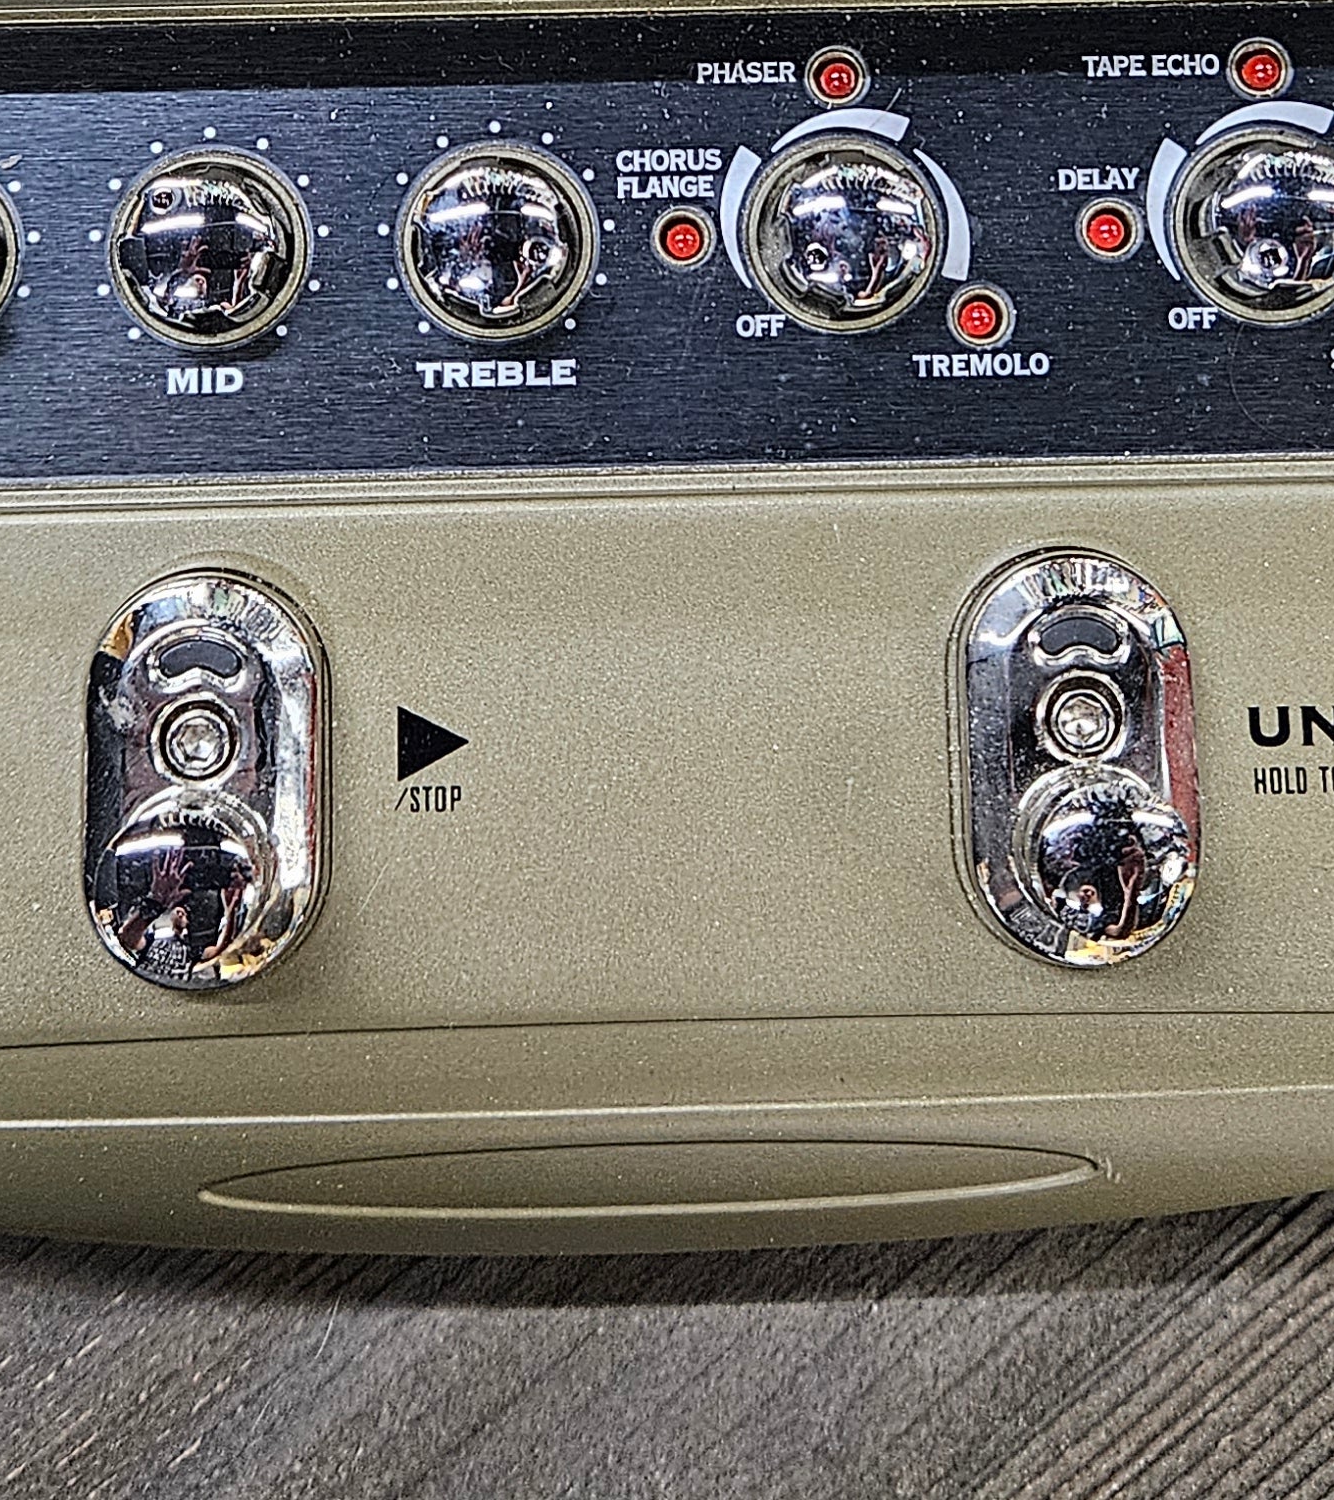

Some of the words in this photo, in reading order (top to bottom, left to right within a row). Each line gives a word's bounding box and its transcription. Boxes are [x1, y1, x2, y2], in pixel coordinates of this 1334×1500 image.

[696, 61, 797, 85] PHASER
[1081, 55, 1147, 78] TAPE
[1151, 53, 1220, 77] ECHO
[616, 148, 722, 173] CHORUS
[616, 174, 715, 199] FLANGE
[1057, 167, 1140, 192] DELAY
[735, 314, 786, 338] OFF
[1168, 306, 1217, 331] OFF
[416, 358, 577, 389] TREBLE
[912, 352, 1050, 378] TREMOLO
[166, 366, 243, 395] MID
[1254, 766, 1307, 794] HOLD
